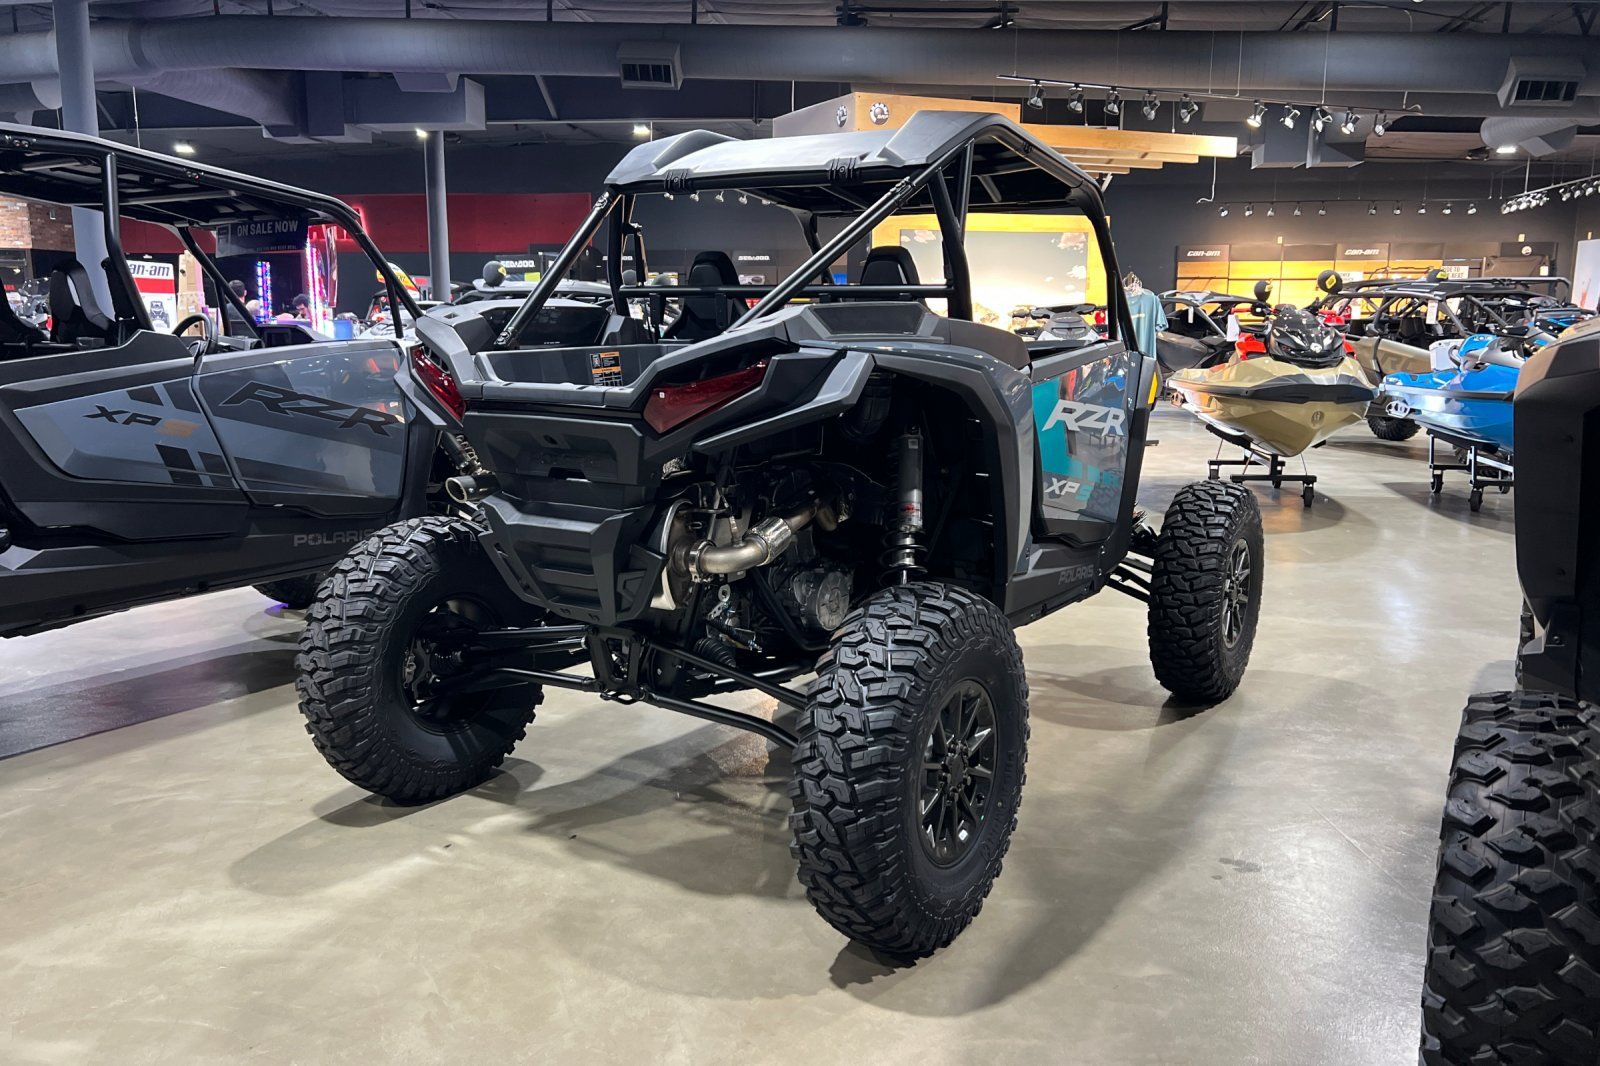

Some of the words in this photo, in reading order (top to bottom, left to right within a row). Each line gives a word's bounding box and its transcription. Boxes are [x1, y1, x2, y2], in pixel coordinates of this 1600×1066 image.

[237, 224, 249, 237] ON
[249, 221, 273, 235] SALE
[274, 220, 298, 233] NOW
[128, 263, 170, 277] an-am
[218, 380, 403, 437] RZR
[1042, 399, 1126, 436] RZR
